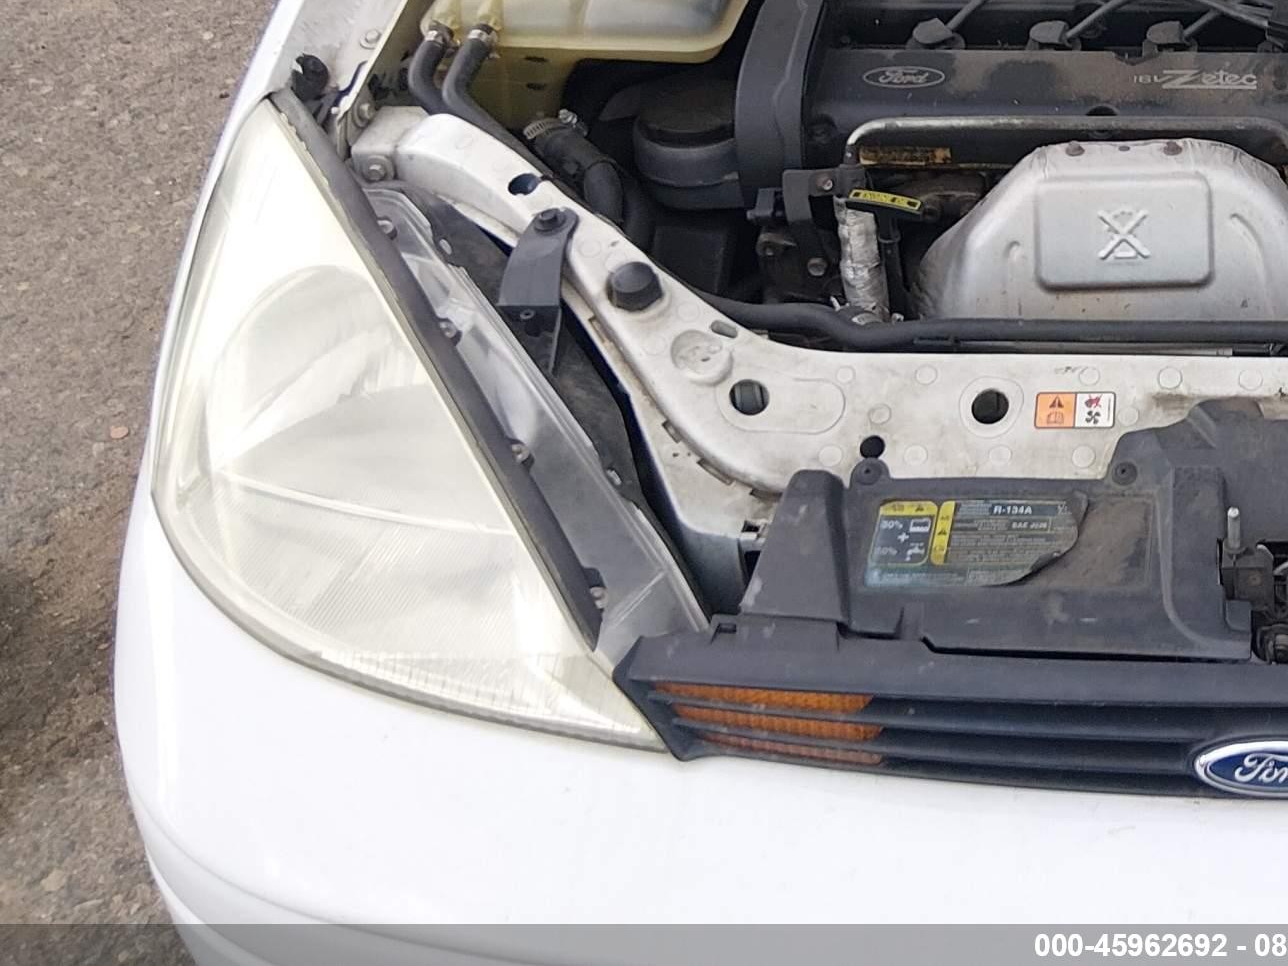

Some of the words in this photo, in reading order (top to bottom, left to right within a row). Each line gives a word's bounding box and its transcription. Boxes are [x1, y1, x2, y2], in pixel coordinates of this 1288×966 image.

[878, 68, 930, 85] Ford
[1161, 69, 1258, 90] Zetec
[993, 505, 1033, 515] R-134A
